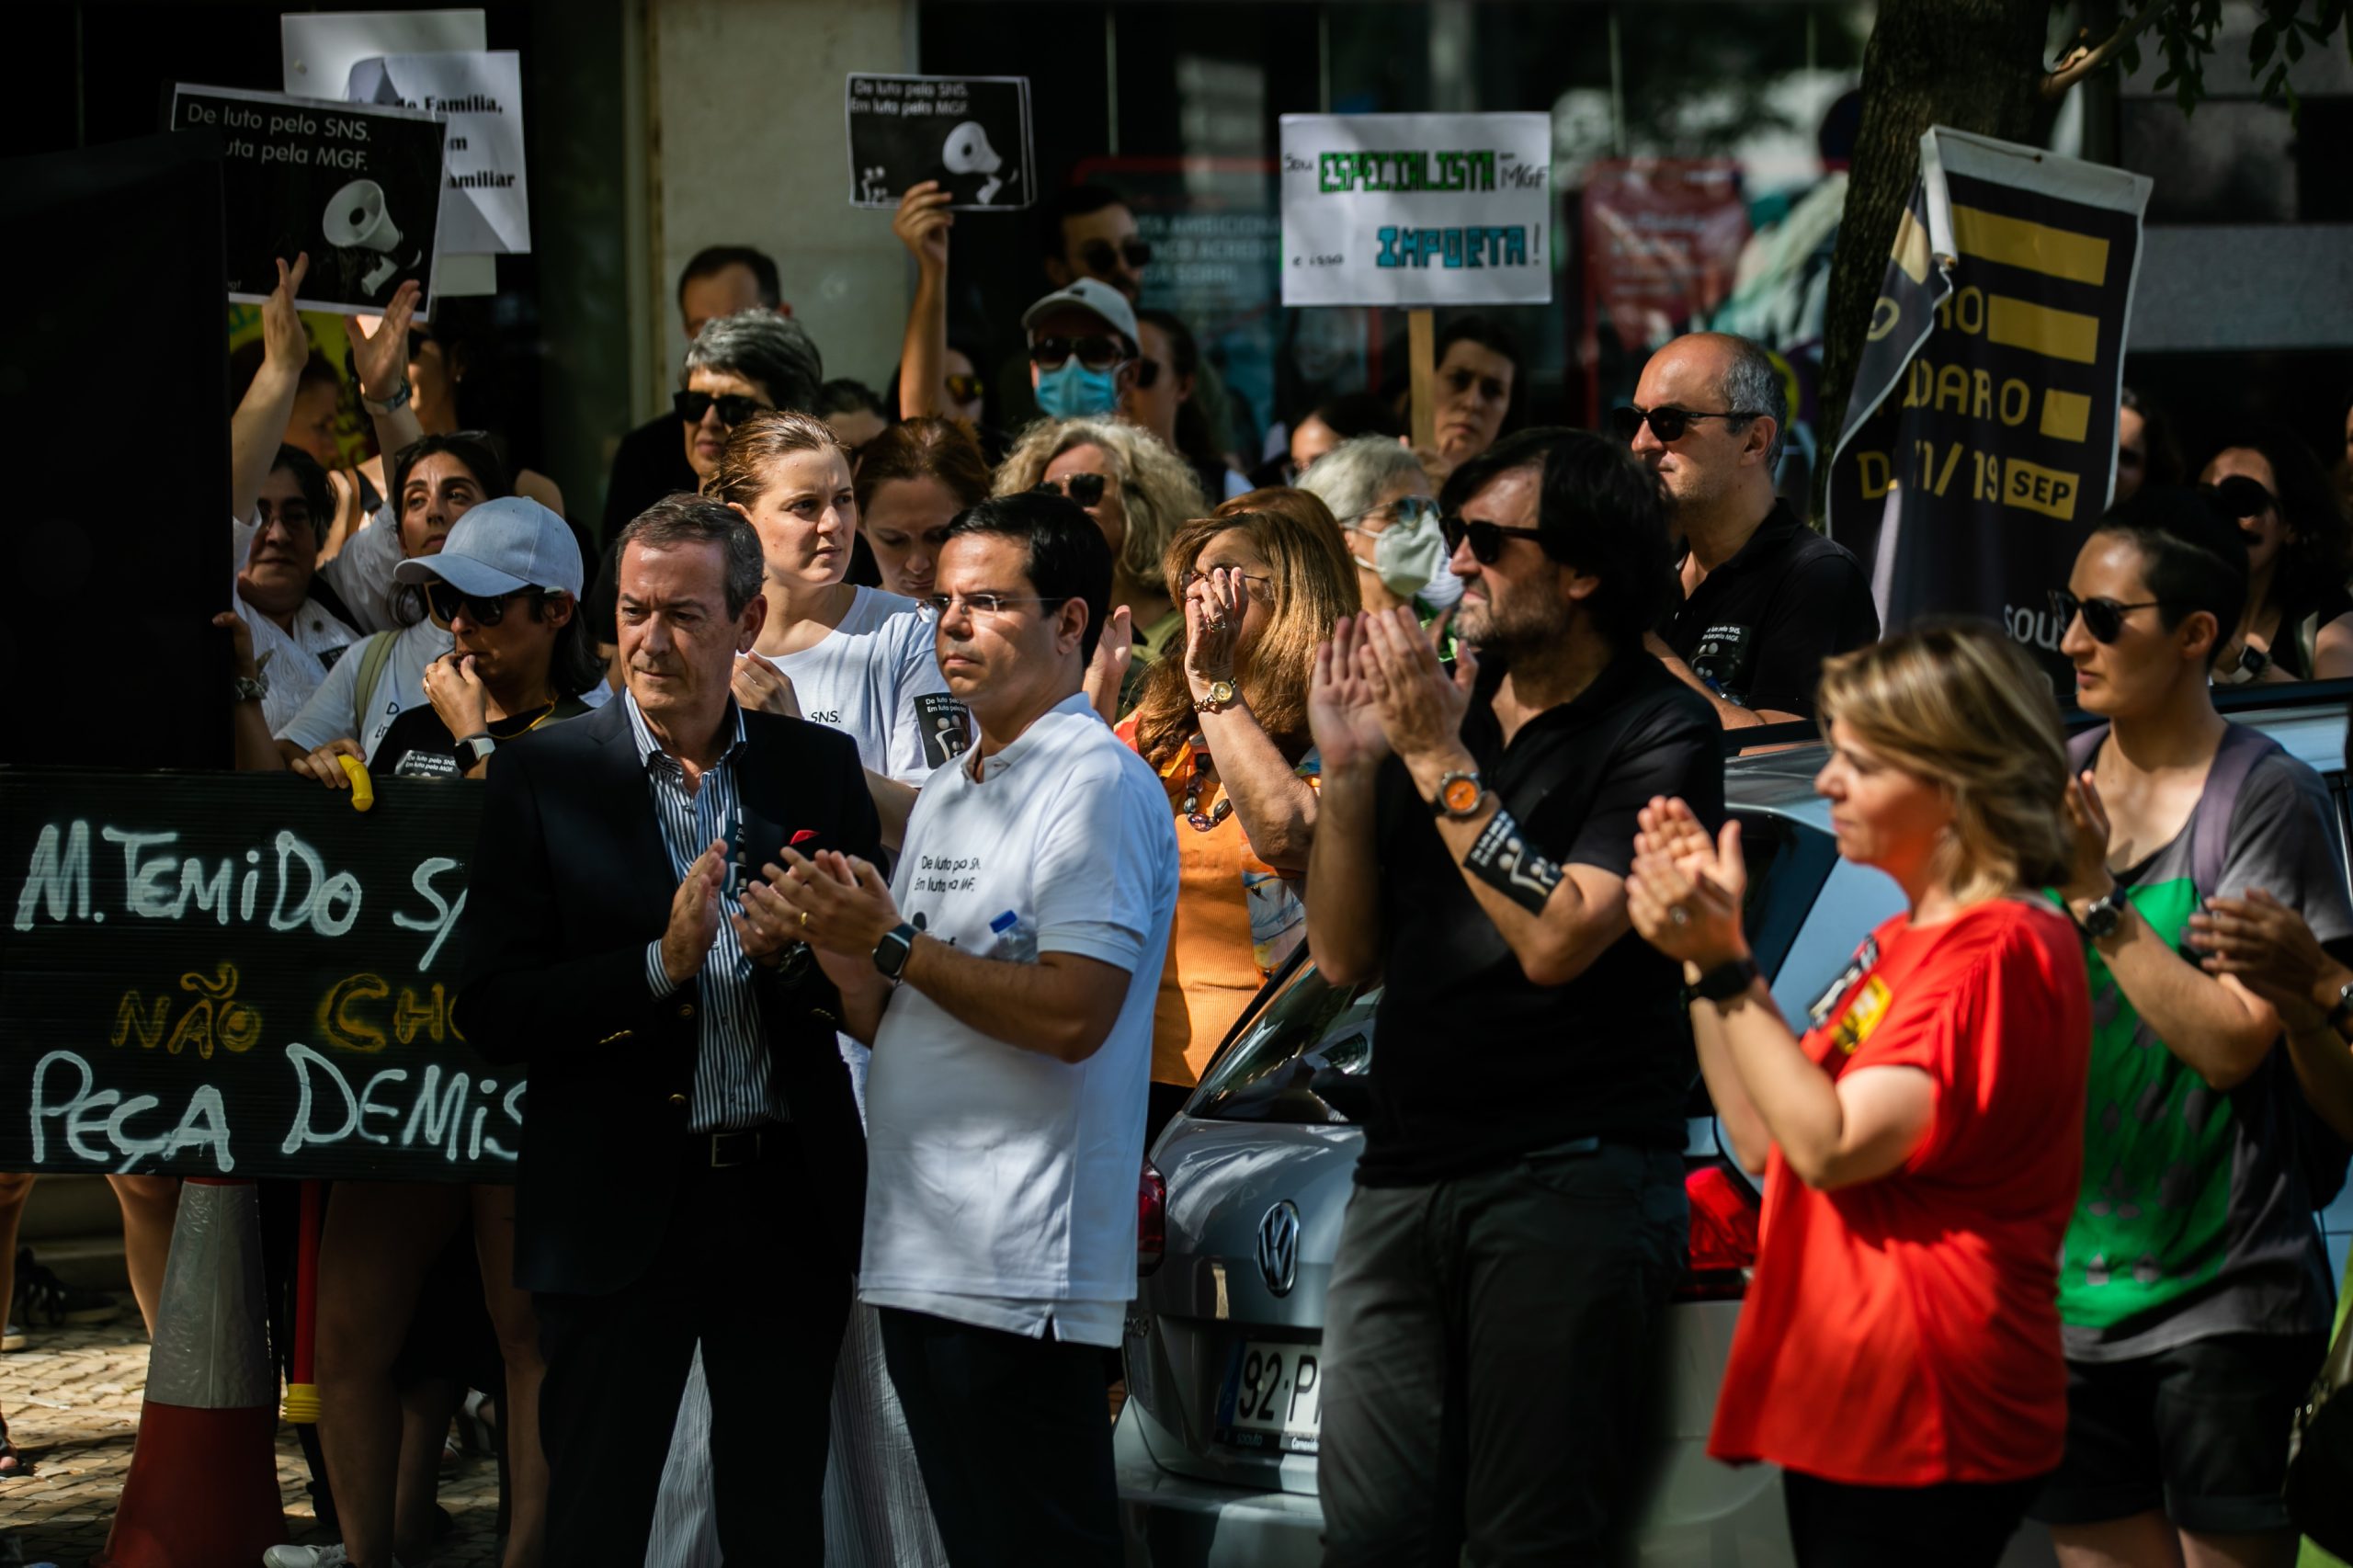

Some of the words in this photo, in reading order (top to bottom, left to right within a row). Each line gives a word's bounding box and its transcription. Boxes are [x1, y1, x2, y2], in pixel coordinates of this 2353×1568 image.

[188, 103, 217, 124] De
[223, 105, 263, 130] luto
[270, 113, 317, 136] pelo
[324, 118, 371, 142] SNS.
[261, 142, 309, 165] pela
[315, 146, 369, 171] MGF.
[1319, 150, 1496, 194] ESPECIALISTA
[447, 170, 516, 188] amiliar
[2012, 470, 2072, 507] SEP
[386, 701, 400, 715] D
[811, 710, 842, 724] SNS.
[921, 855, 934, 870] De
[933, 855, 953, 871] luto
[110, 962, 263, 1060] NÃO
[30, 1049, 236, 1175] PEÇA
